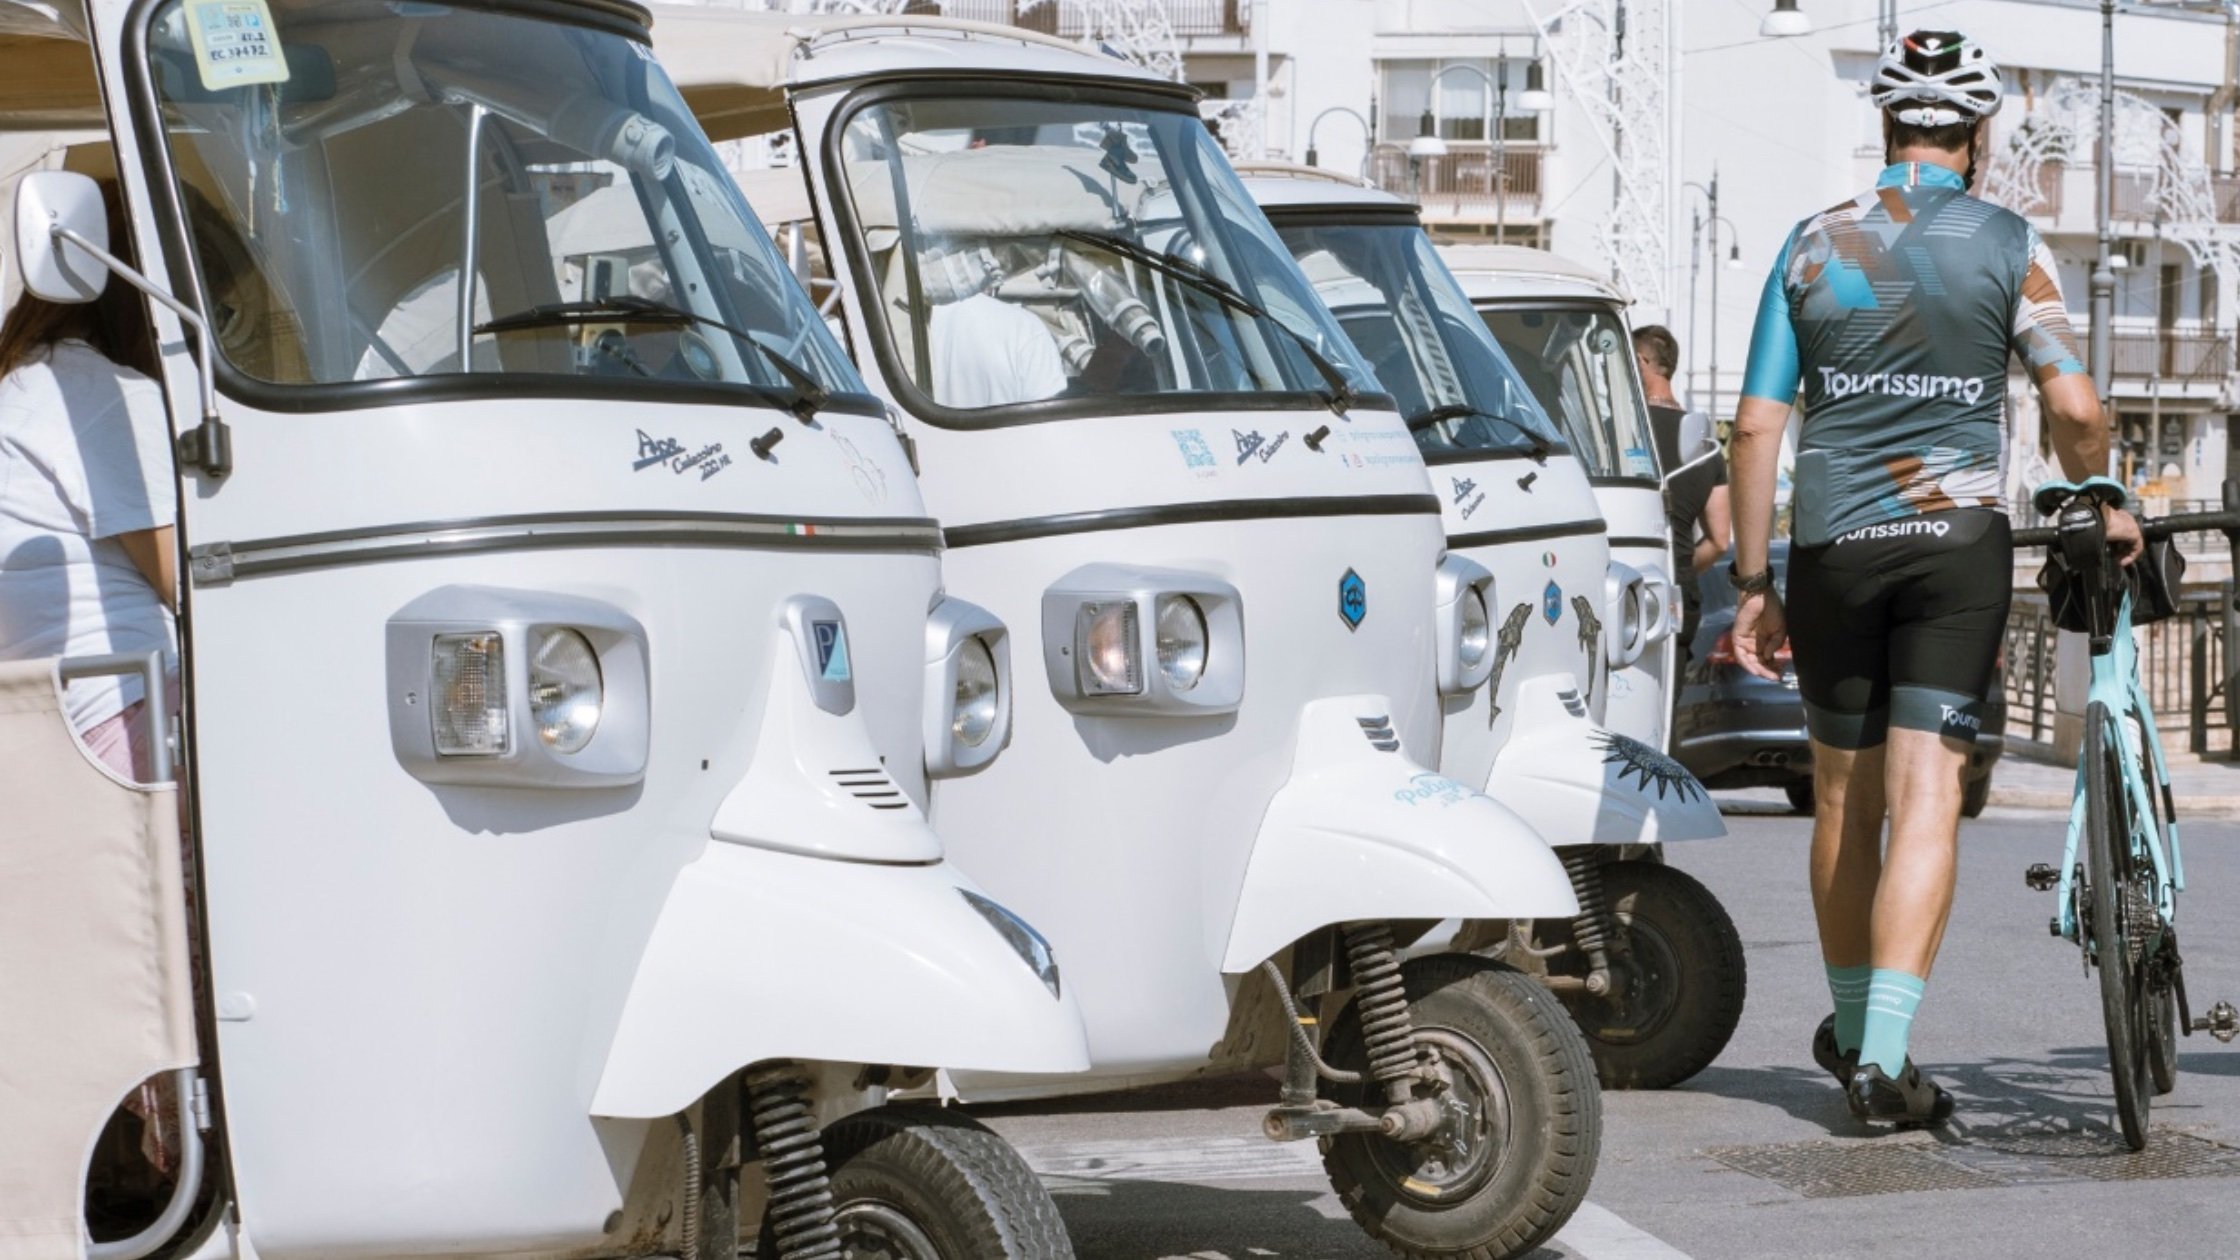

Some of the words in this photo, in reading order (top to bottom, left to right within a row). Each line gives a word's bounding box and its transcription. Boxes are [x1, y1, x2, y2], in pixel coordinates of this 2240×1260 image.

[1818, 366, 1984, 405] Tourissimo
[633, 427, 686, 471] Ape
[1836, 520, 1950, 545] urissimo
